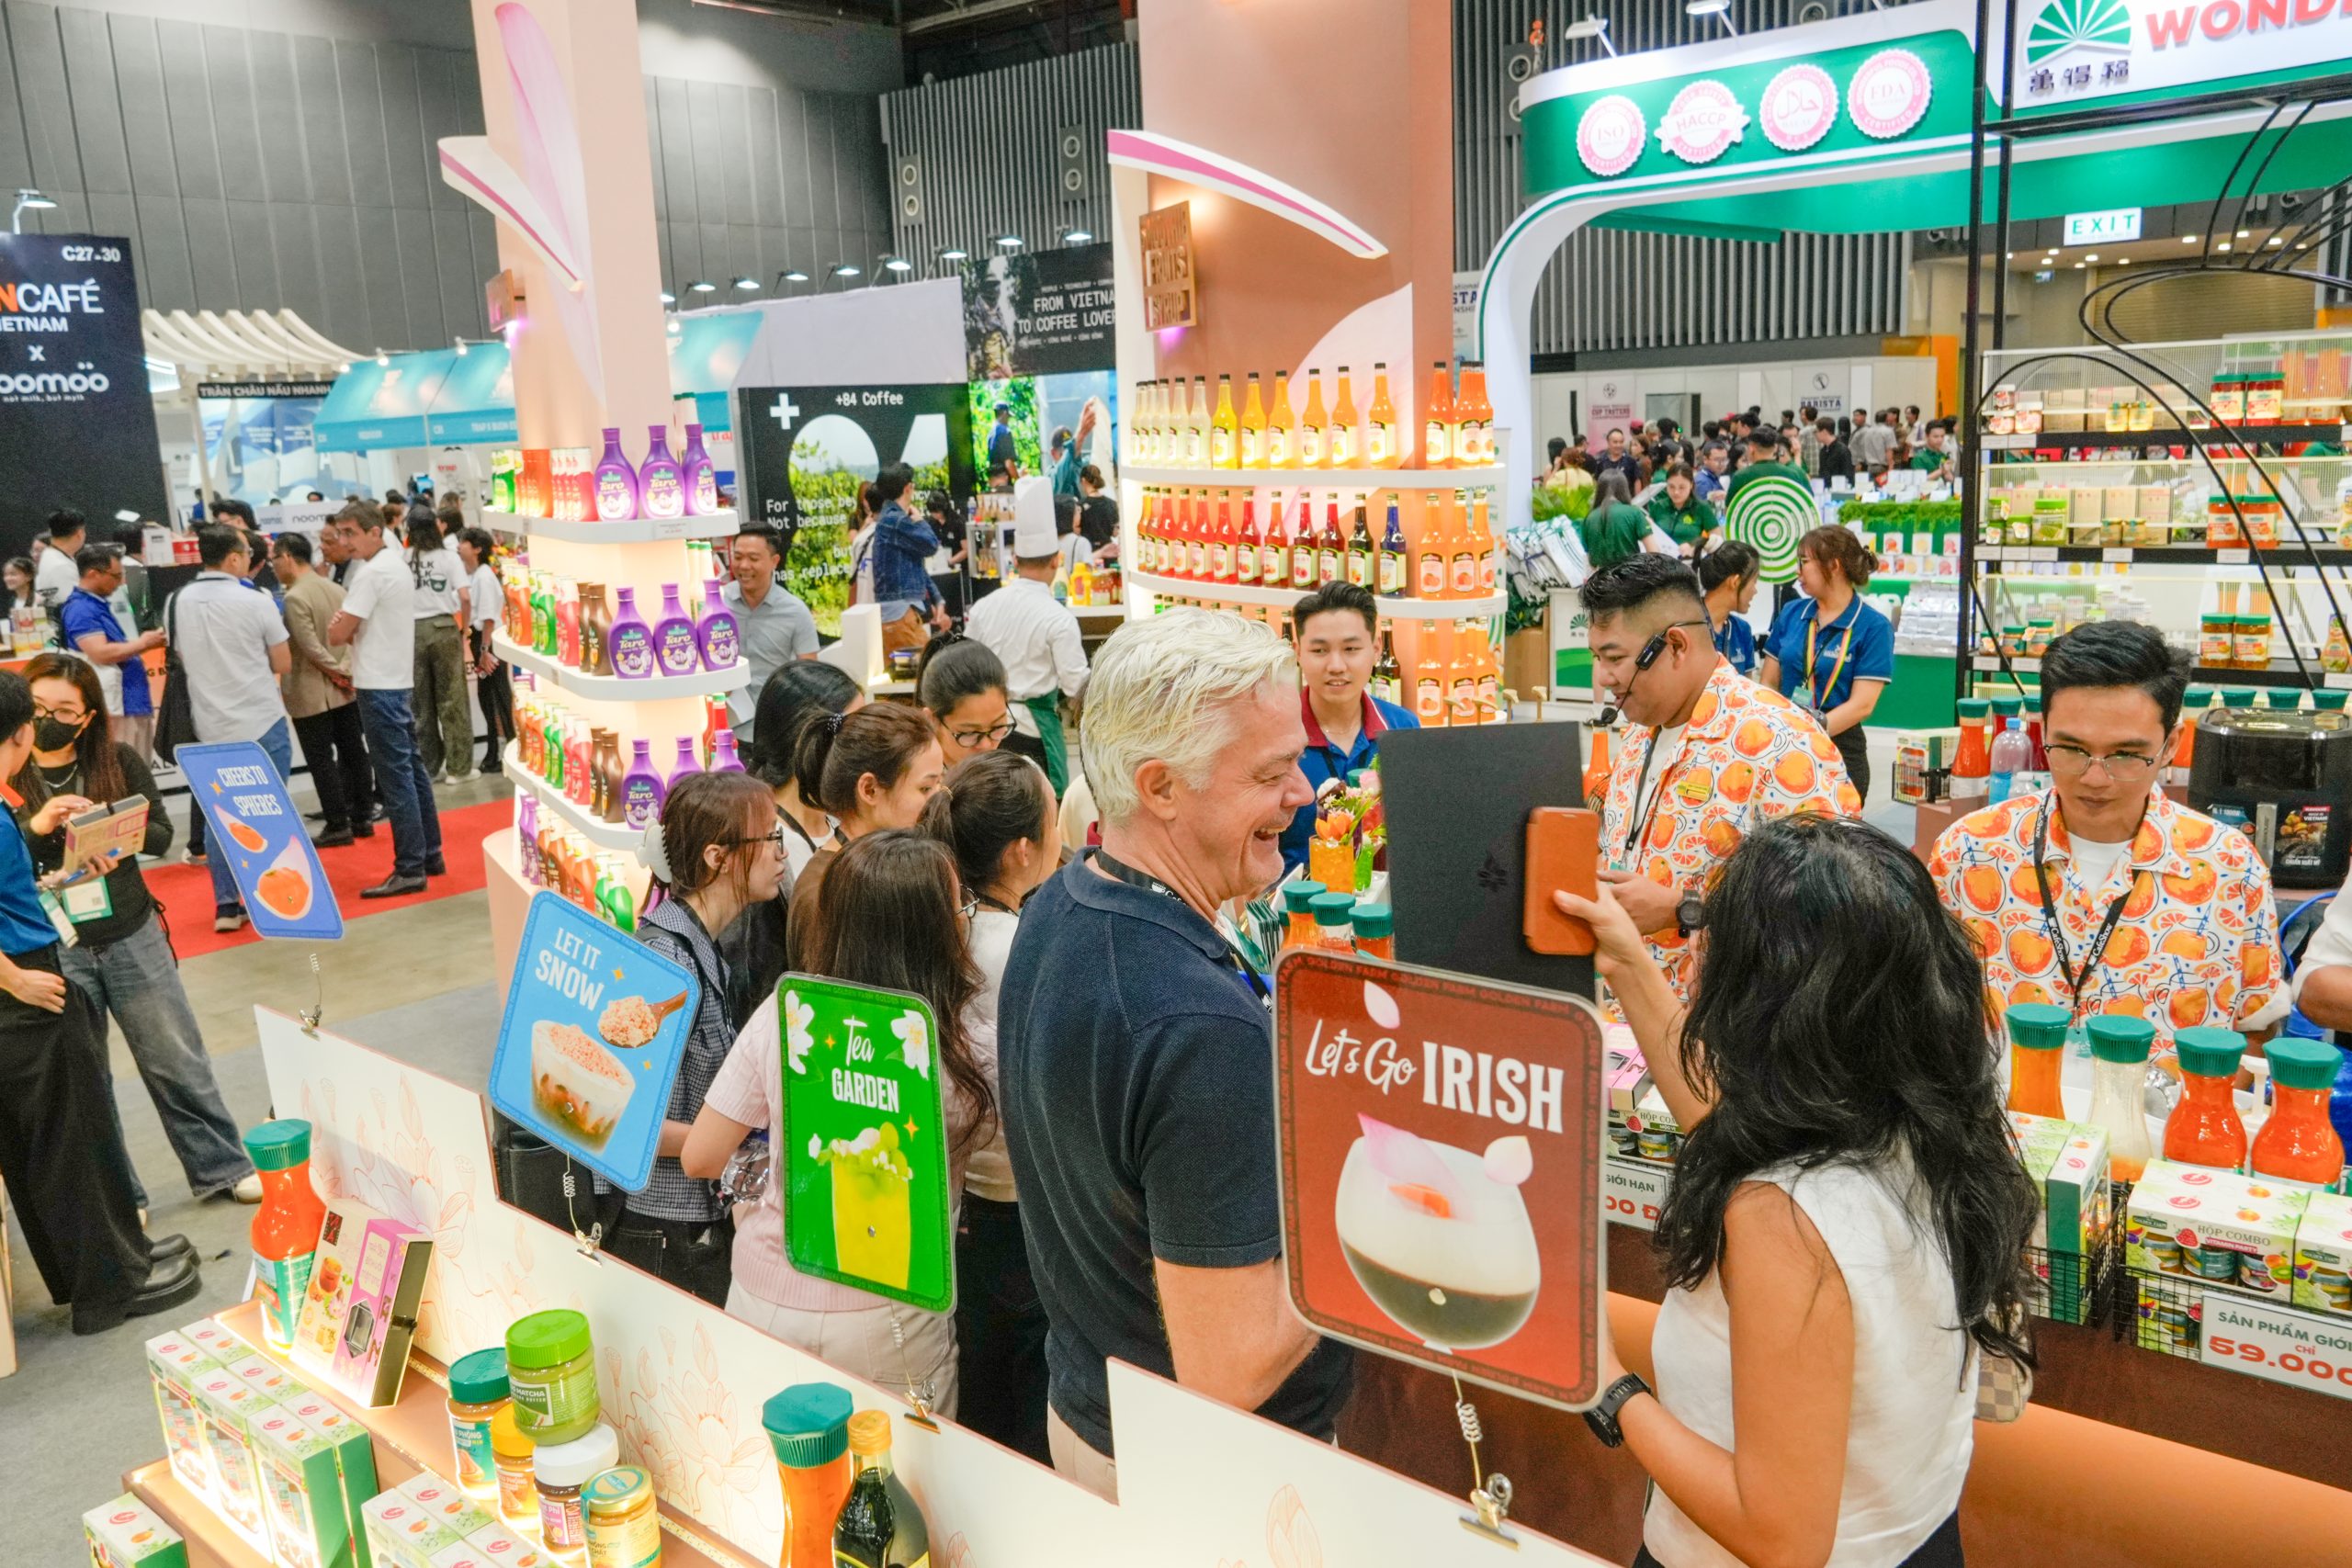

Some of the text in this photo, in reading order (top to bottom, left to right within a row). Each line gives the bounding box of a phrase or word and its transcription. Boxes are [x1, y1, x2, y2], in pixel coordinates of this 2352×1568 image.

[2146, 0, 2352, 47] WOND
[1676, 112, 1727, 132] HACCP
[2072, 214, 2136, 235] EXIT
[62, 245, 121, 262] C27-30
[1034, 297, 1064, 313] FROM
[1018, 320, 1031, 334] TO
[1036, 313, 1078, 332] COFFEE
[862, 390, 904, 406] Coffee
[766, 499, 788, 513] For
[797, 497, 831, 510] those
[768, 513, 847, 530] Not because
[665, 635, 692, 645] Taro
[710, 630, 734, 639] Taro
[619, 639, 646, 649] Taro
[217, 765, 269, 787] CHEERS TO
[628, 792, 654, 800] Taro
[232, 794, 283, 817] SPHERES
[554, 927, 603, 971] LET IT
[535, 949, 605, 1011] SNOW
[842, 1015, 875, 1066] Tea
[831, 1067, 899, 1113] GARDEN
[1364, 1037, 1417, 1096] Go
[1422, 1040, 1565, 1134] IRISH
[1629, 1178, 1655, 1193] HẠN
[2207, 1237, 2257, 1254] VITAMIN PARTY
[2226, 1231, 2271, 1247] COMBO
[2219, 1311, 2253, 1328] SẢN
[2258, 1322, 2309, 1341] PHẨM
[516, 1388, 545, 1397] MATCHA
